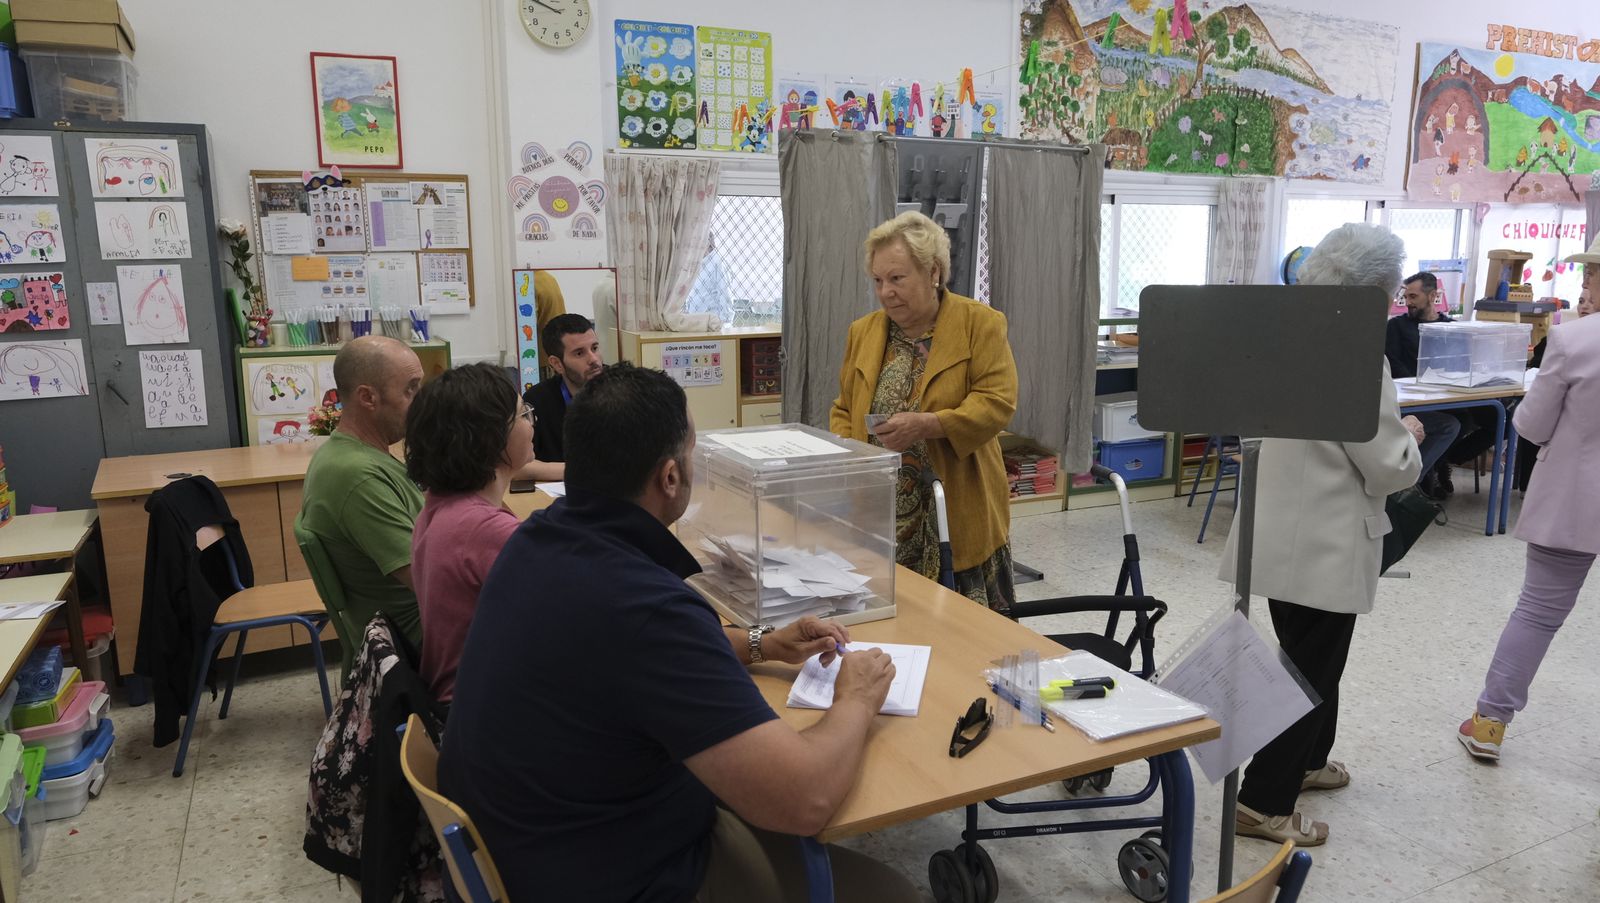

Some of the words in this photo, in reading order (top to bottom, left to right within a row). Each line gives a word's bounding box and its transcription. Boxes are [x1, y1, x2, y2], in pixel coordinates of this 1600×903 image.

[528, 5, 534, 13] 9
[577, 9, 583, 17] 3
[532, 18, 539, 26] 8
[541, 27, 548, 35] 7
[565, 29, 571, 37] 5
[554, 32, 561, 40] 6
[364, 145, 384, 153] PEPO
[525, 233, 549, 241] GRACIAS
[572, 230, 582, 238] DE
[581, 230, 597, 238] NADA
